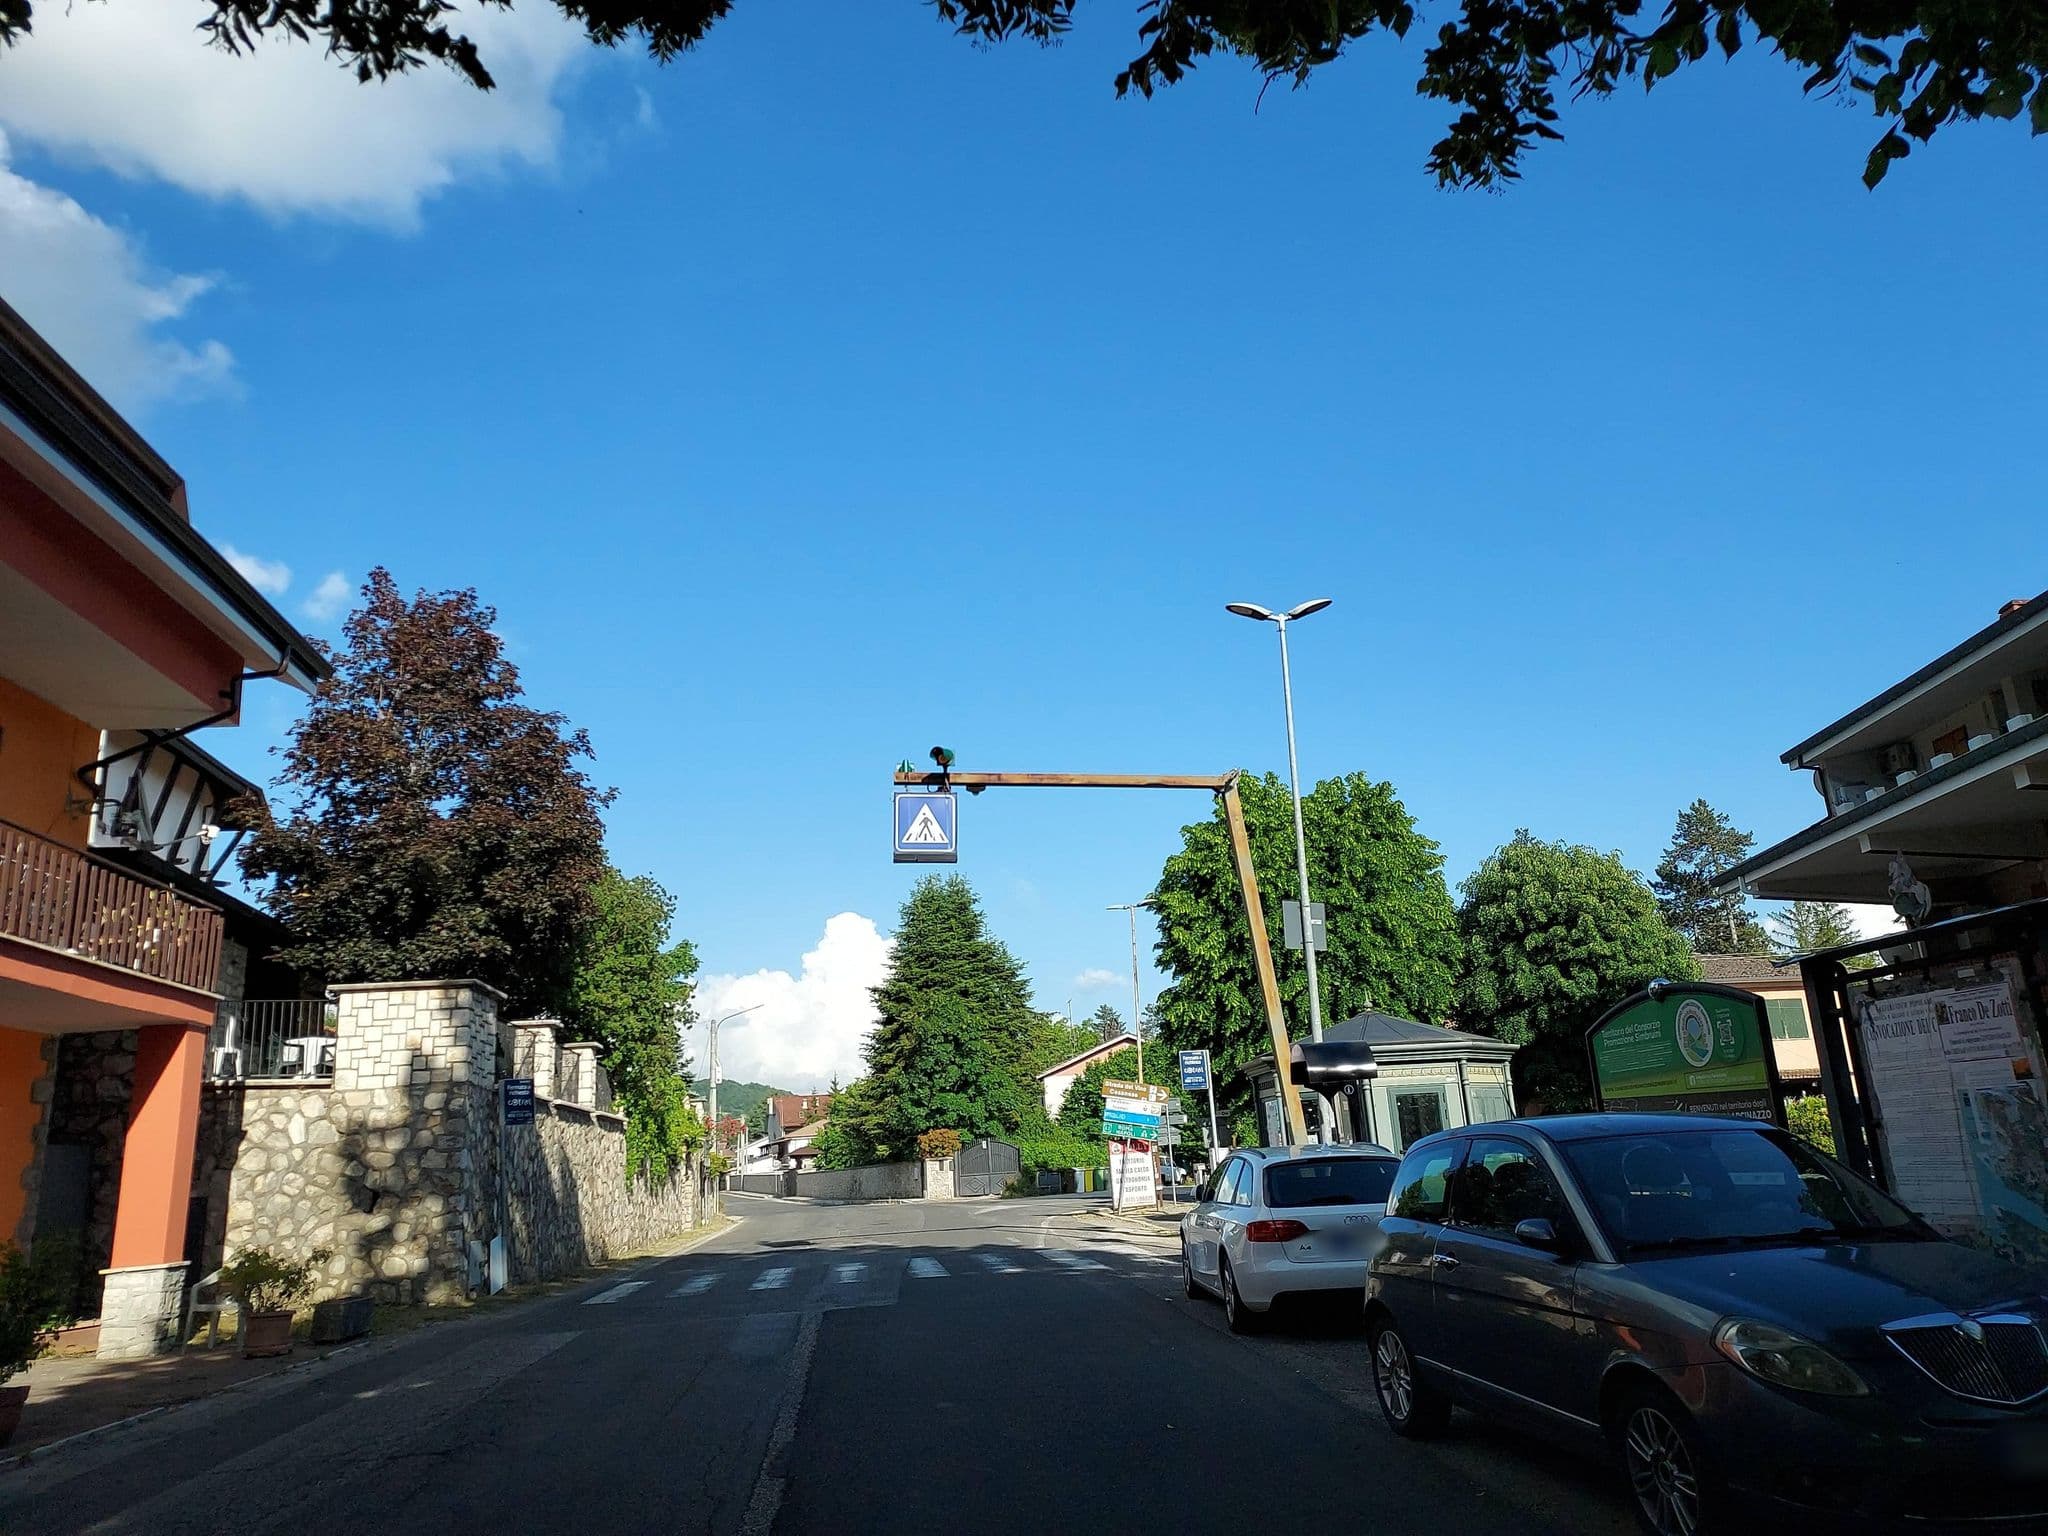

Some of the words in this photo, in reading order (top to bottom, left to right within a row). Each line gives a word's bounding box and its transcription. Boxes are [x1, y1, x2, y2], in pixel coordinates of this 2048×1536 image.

[1948, 1005, 1977, 1023] Franco
[1976, 1001, 1989, 1020] De
[1625, 1024, 1633, 1034] del
[1634, 1020, 1661, 1032] Consorzio
[1865, 1019, 1915, 1041] CONVOCAZIONE
[1104, 1080, 1124, 1089] Strada
[508, 1099, 532, 1107] cotral
[1689, 1103, 1719, 1113] BENVENUTI
[1719, 1101, 1728, 1110] nel
[1116, 1176, 1150, 1184] GSTRONOMIA
